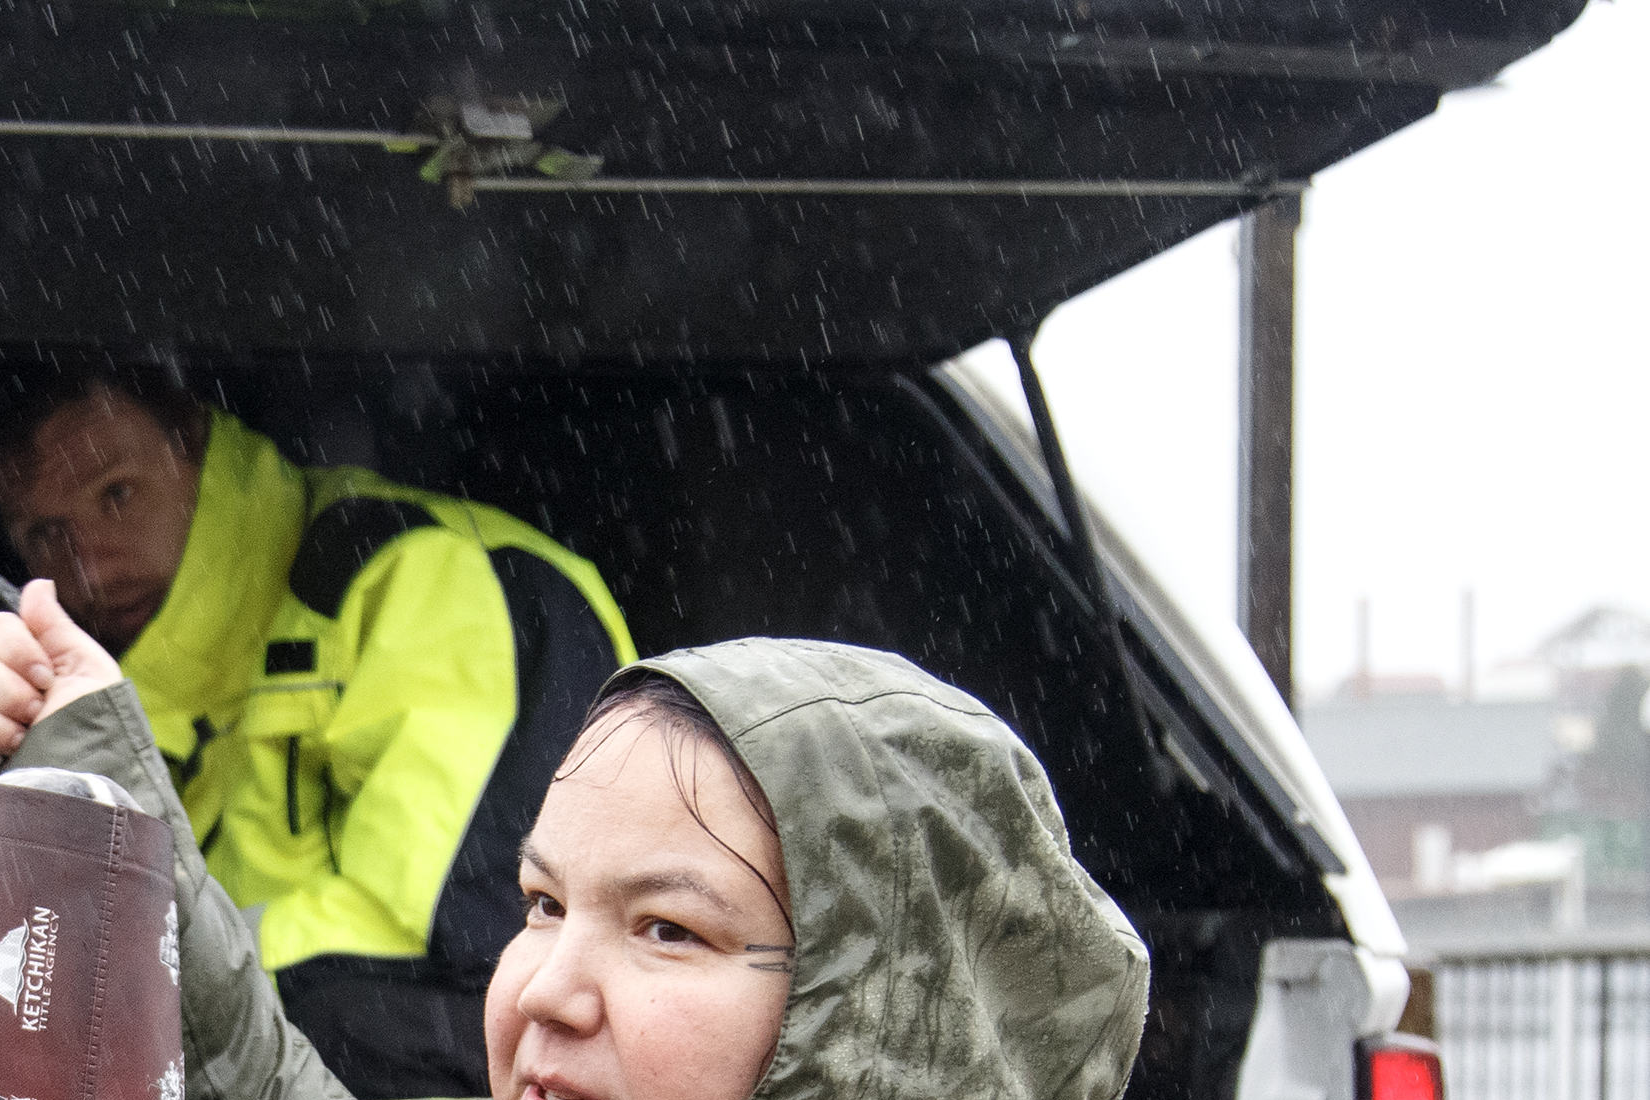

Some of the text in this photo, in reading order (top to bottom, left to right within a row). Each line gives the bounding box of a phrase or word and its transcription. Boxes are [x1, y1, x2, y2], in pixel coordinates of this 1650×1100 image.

[22, 906, 51, 1031] KETCHIKAN
[38, 911, 59, 1031] TITLE AGENCY
